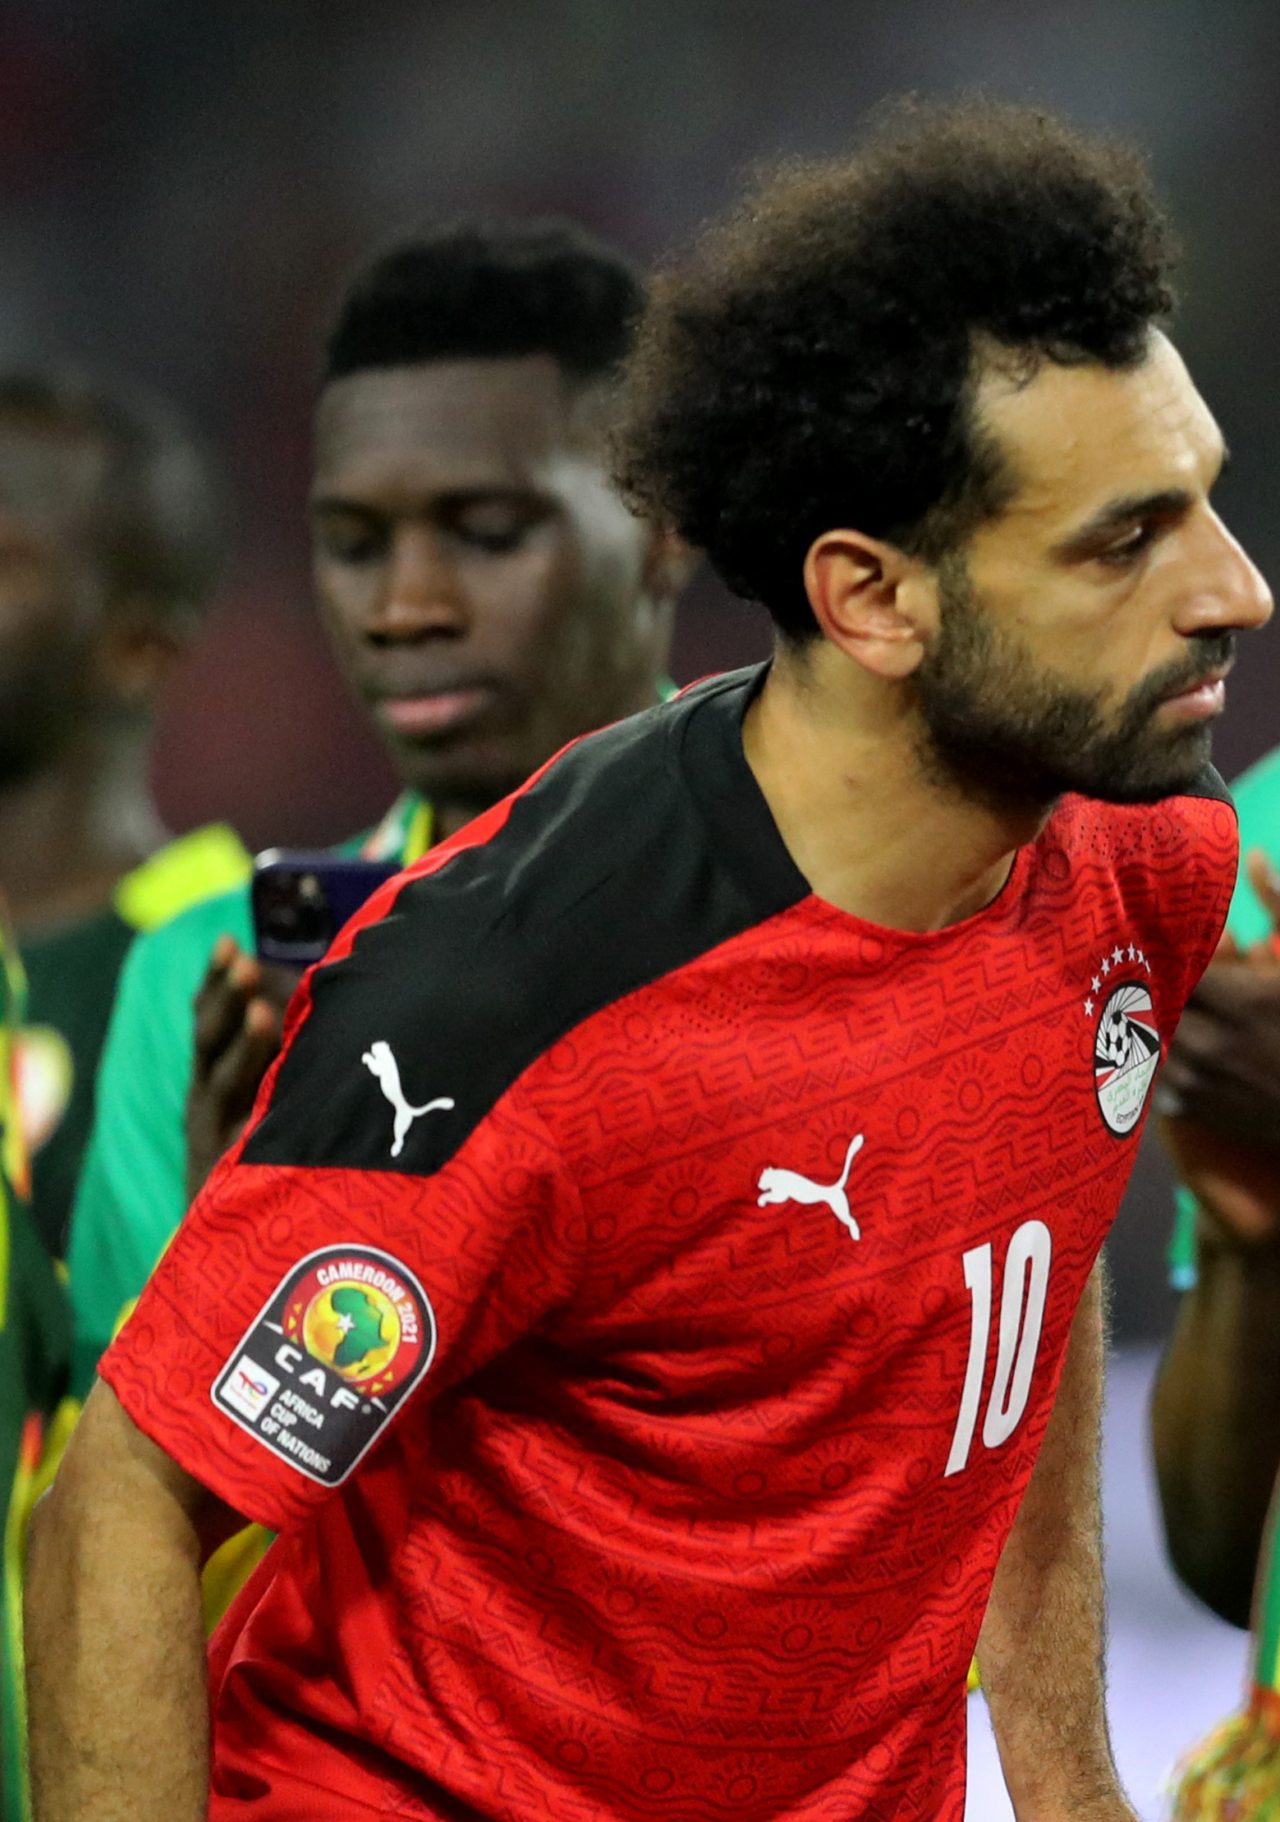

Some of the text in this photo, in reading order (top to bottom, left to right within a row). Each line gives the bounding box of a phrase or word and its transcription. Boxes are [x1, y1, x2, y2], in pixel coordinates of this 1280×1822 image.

[316, 1261, 419, 1345] CAMEROON 2021
[273, 1343, 361, 1411] CAF
[944, 1219, 1052, 1478] 10
[270, 1402, 299, 1428] CUP
[279, 1389, 325, 1430] AFRICA
[260, 1415, 332, 1474] OF NATIONS
